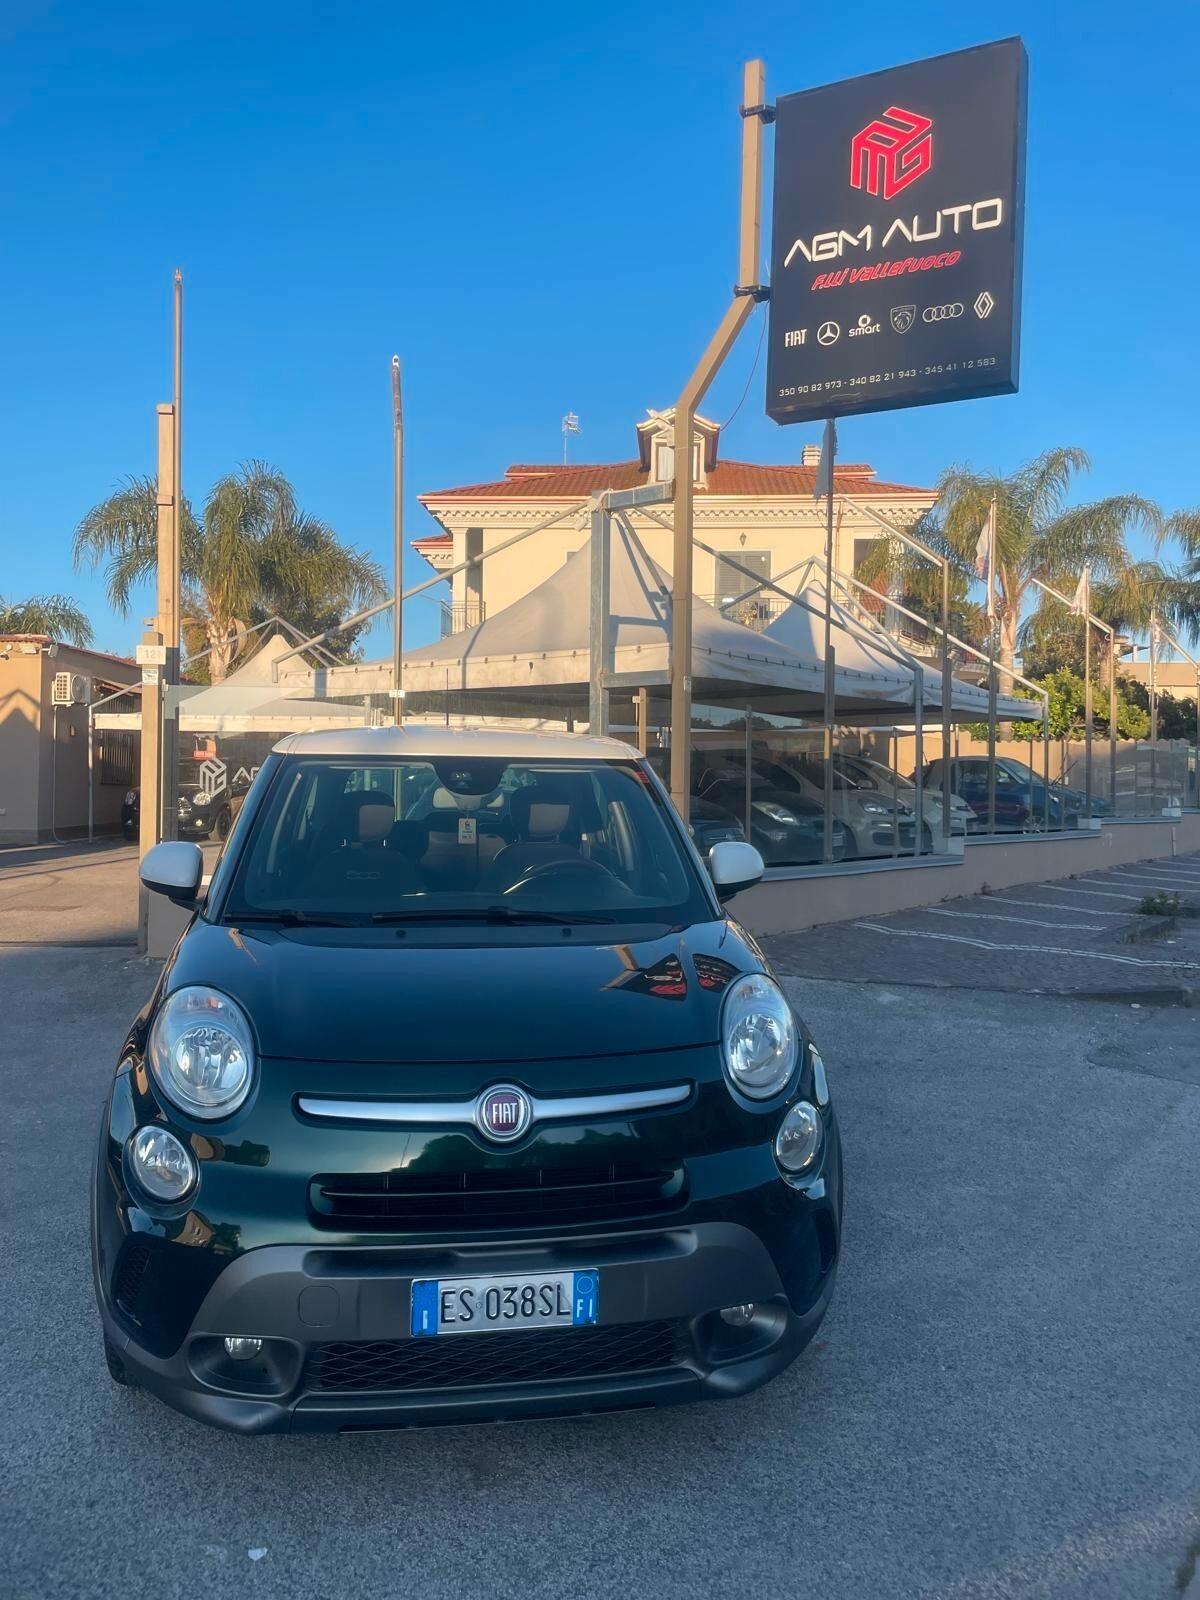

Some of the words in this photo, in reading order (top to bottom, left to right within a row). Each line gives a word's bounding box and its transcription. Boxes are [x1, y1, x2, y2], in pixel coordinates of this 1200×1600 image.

[784, 225, 872, 267] AGM
[882, 198, 1002, 248] AUTO
[785, 328, 807, 347] FIAT
[848, 322, 880, 337] smart
[779, 387, 795, 397] 350
[798, 385, 809, 393] 90
[811, 383, 822, 391] 82
[825, 380, 842, 389] 973
[849, 376, 867, 386] 340
[869, 374, 881, 383] 82
[884, 372, 895, 381] 21
[898, 369, 916, 379] 943
[924, 365, 943, 375] 345
[946, 363, 957, 371] 41
[963, 360, 974, 369] 12
[977, 357, 996, 367] 583
[492, 1102, 518, 1124] FIAT
[440, 1288, 474, 1323] ES
[486, 1282, 571, 1320] 038SL
[576, 1298, 593, 1319] FI
[422, 1310, 428, 1330] I
